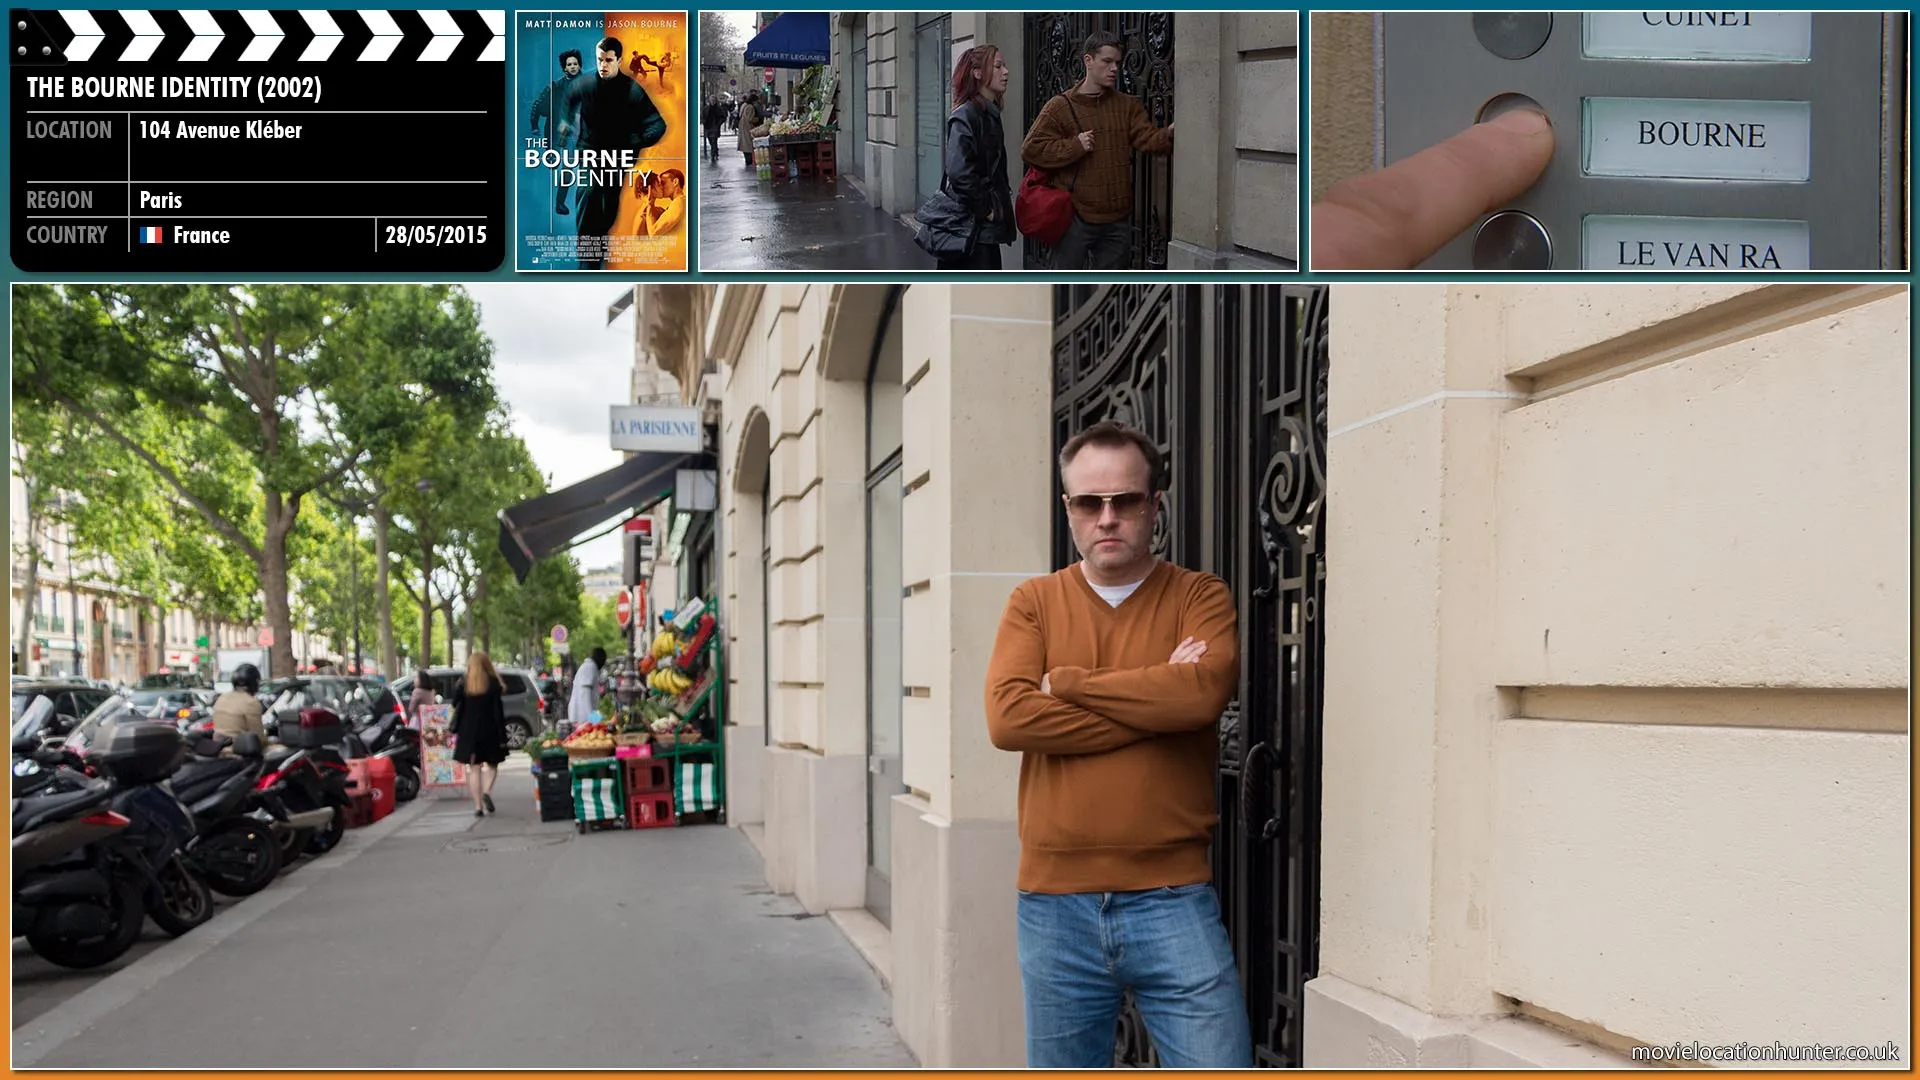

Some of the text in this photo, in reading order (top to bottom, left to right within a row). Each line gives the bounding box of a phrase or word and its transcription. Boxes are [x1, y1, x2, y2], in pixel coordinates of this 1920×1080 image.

[525, 20, 678, 28] MATT DAMON IS JASON BOURNE
[752, 51, 779, 60] FRUITS
[525, 137, 548, 148] THE
[1638, 120, 1766, 148] BOURNE
[525, 149, 634, 168] BOURNE
[554, 169, 652, 187] IDENTITY
[1618, 241, 1782, 269] LE VAN RA
[611, 420, 698, 436] LA PARISIENNE
